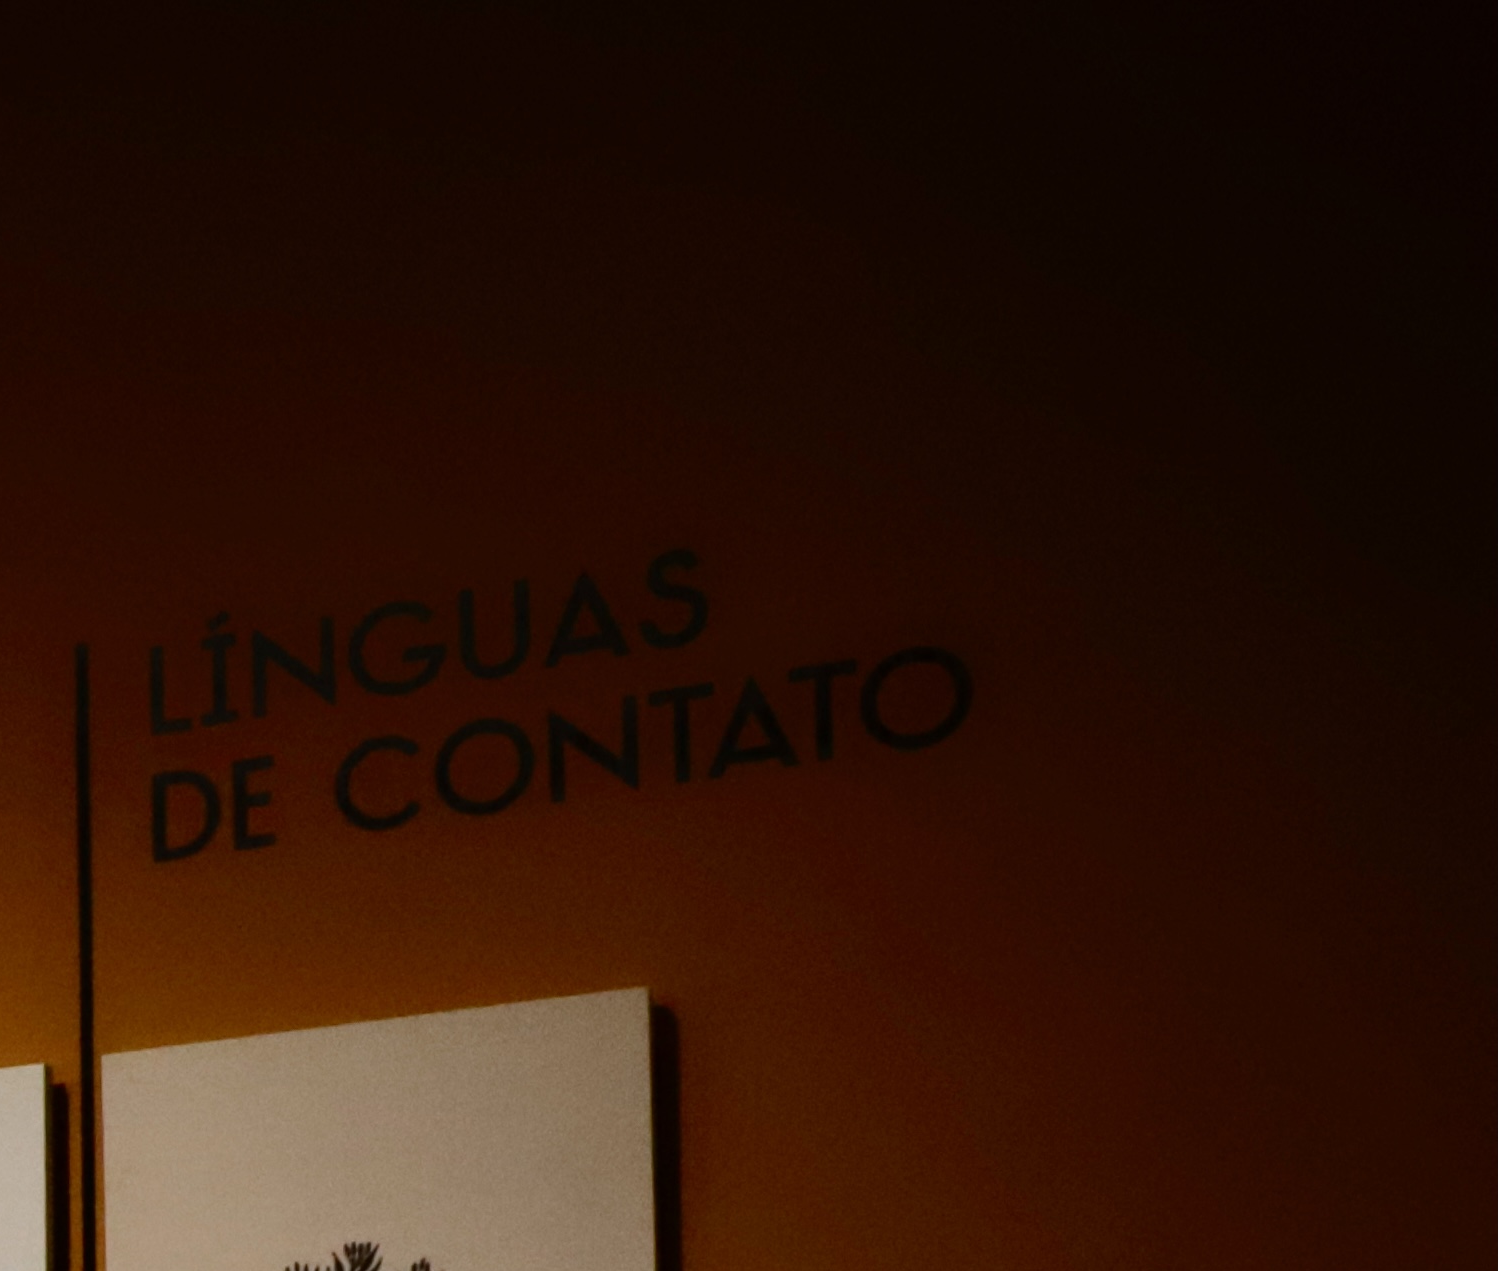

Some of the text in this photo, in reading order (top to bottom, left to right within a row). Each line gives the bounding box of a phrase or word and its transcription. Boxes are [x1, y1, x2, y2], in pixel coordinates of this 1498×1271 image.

[149, 548, 708, 736] LÍNGUAS
[151, 643, 974, 863] DE CONTATO
